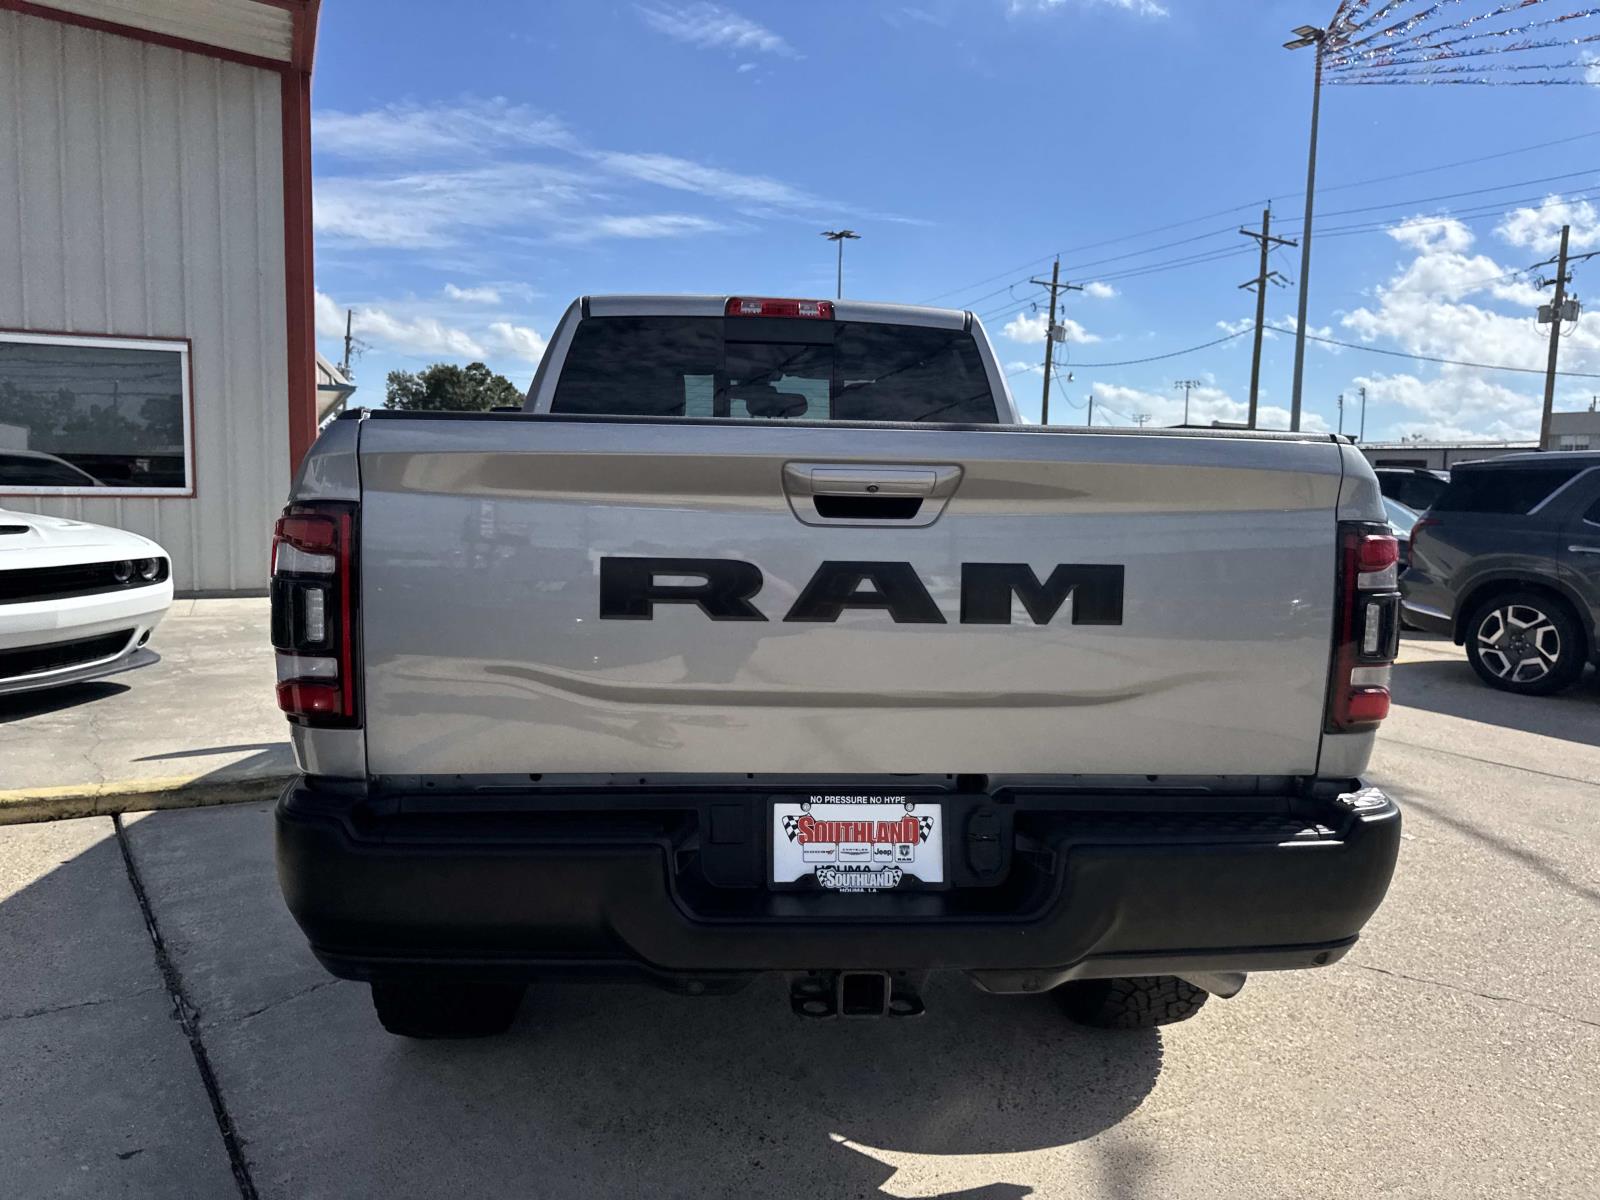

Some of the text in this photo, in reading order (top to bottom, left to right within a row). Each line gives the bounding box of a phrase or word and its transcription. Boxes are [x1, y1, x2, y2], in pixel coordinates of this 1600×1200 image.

[600, 556, 1125, 625] RAM
[810, 795, 906, 804] NO PRESSURE NO HYPE
[797, 815, 920, 845] SOUTHLAND
[874, 848, 892, 857] Jeep
[826, 871, 894, 887] SOUTHLAND
